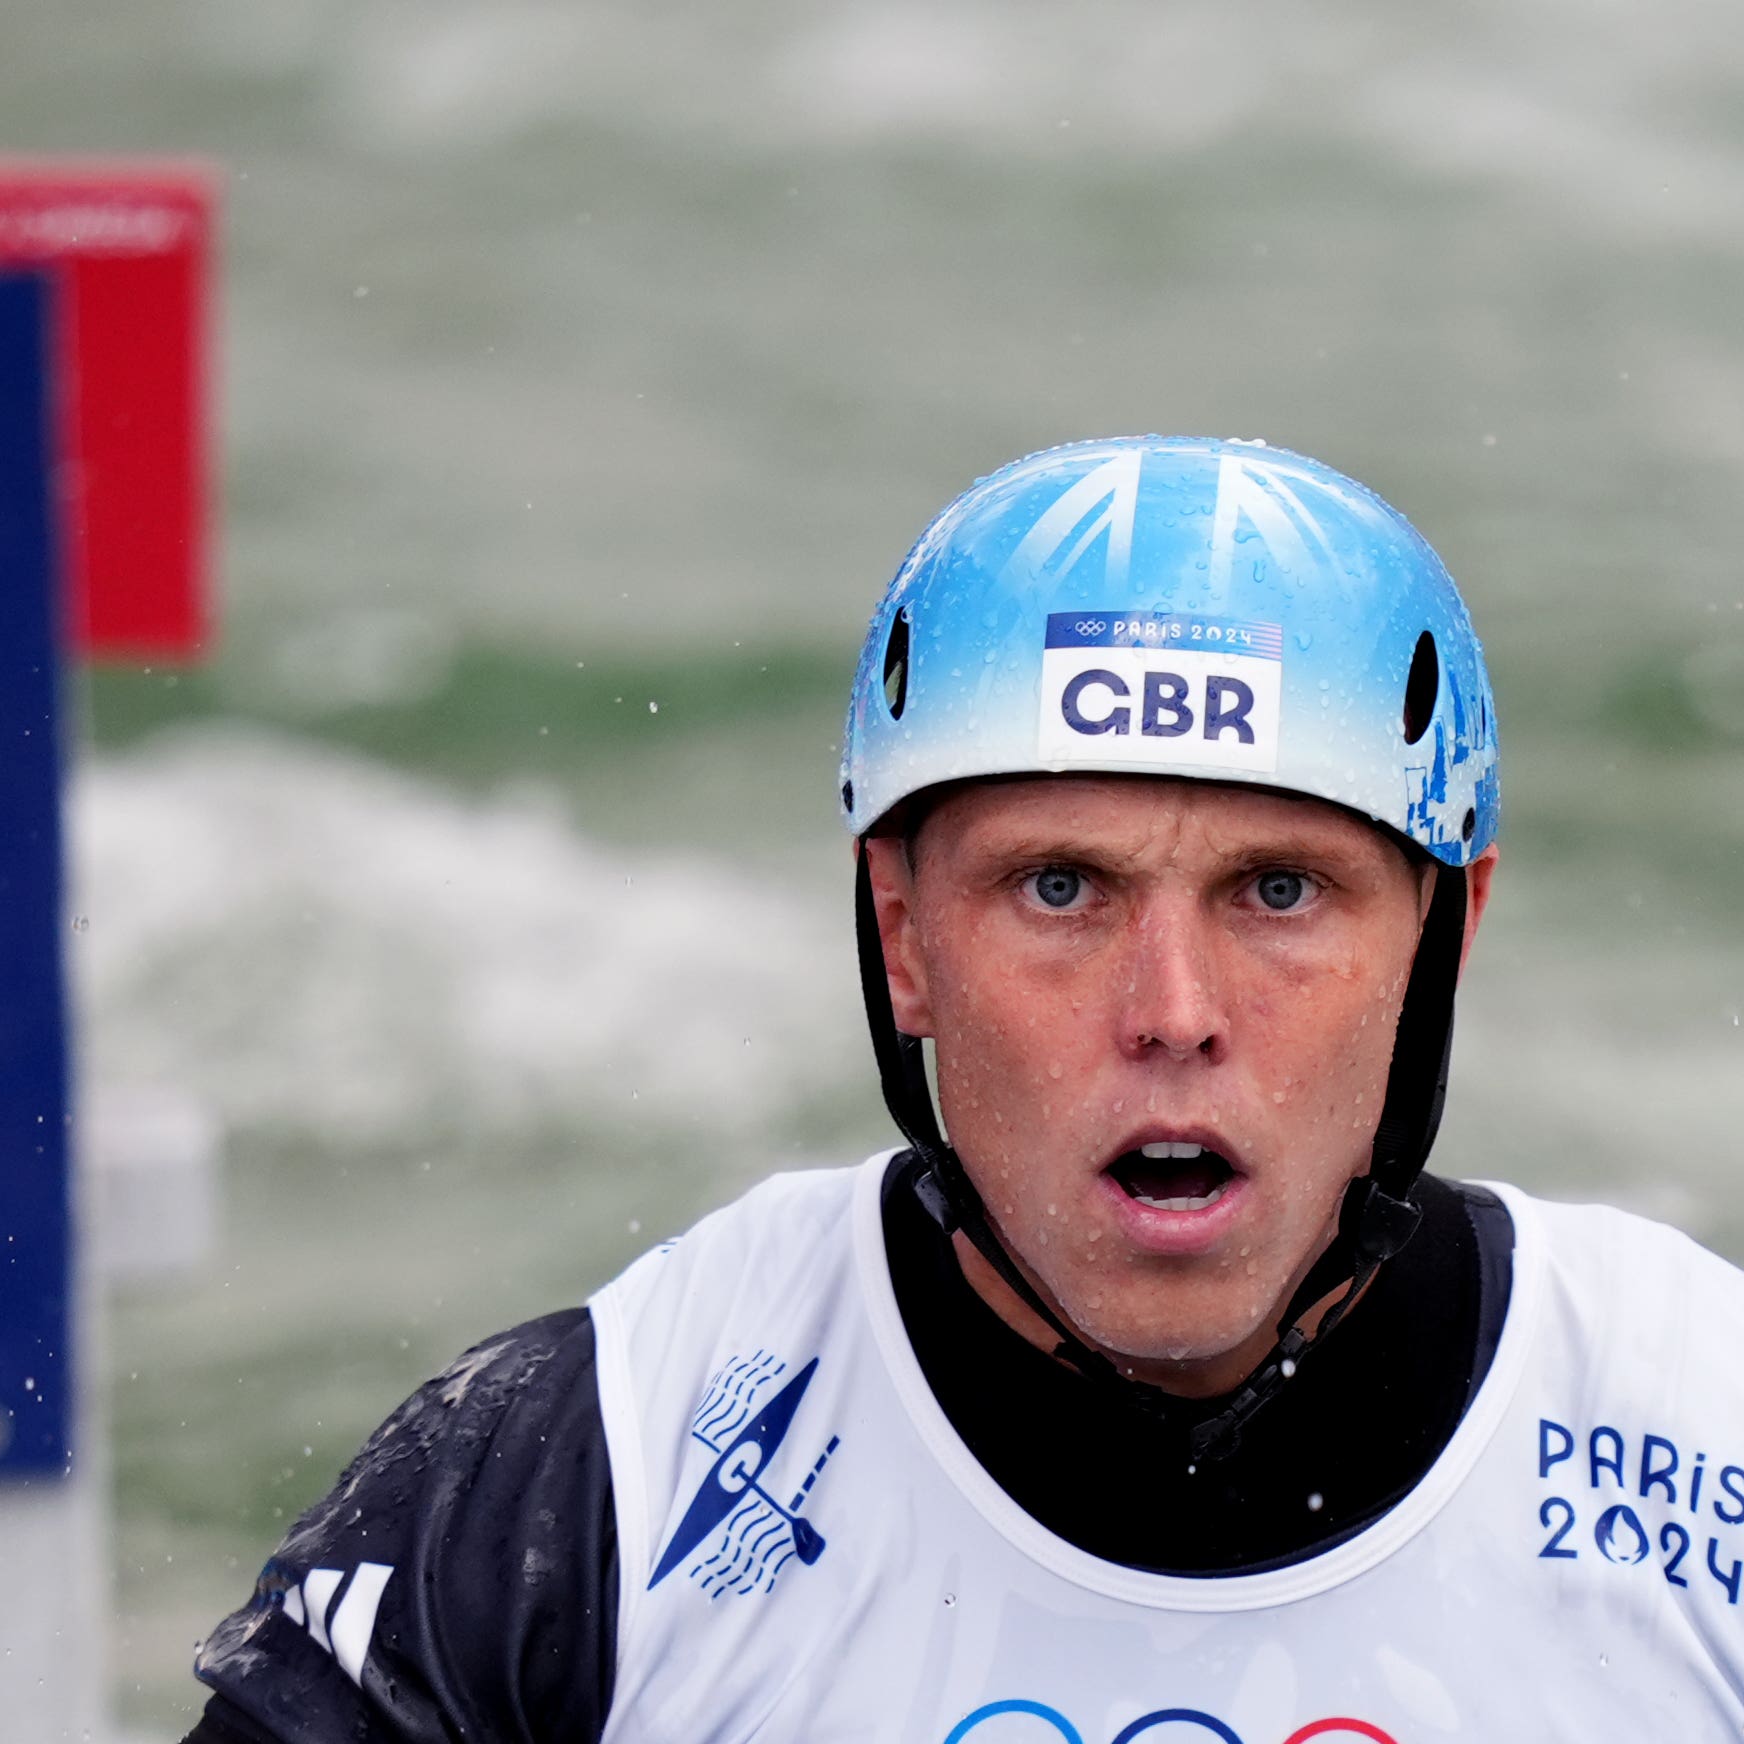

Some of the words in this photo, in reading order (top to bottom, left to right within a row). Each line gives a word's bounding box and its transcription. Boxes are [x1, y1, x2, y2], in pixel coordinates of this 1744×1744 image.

[1191, 625, 1252, 645] 2024
[1061, 669, 1255, 745] GBR
[1537, 1496, 1743, 1605] 2024
